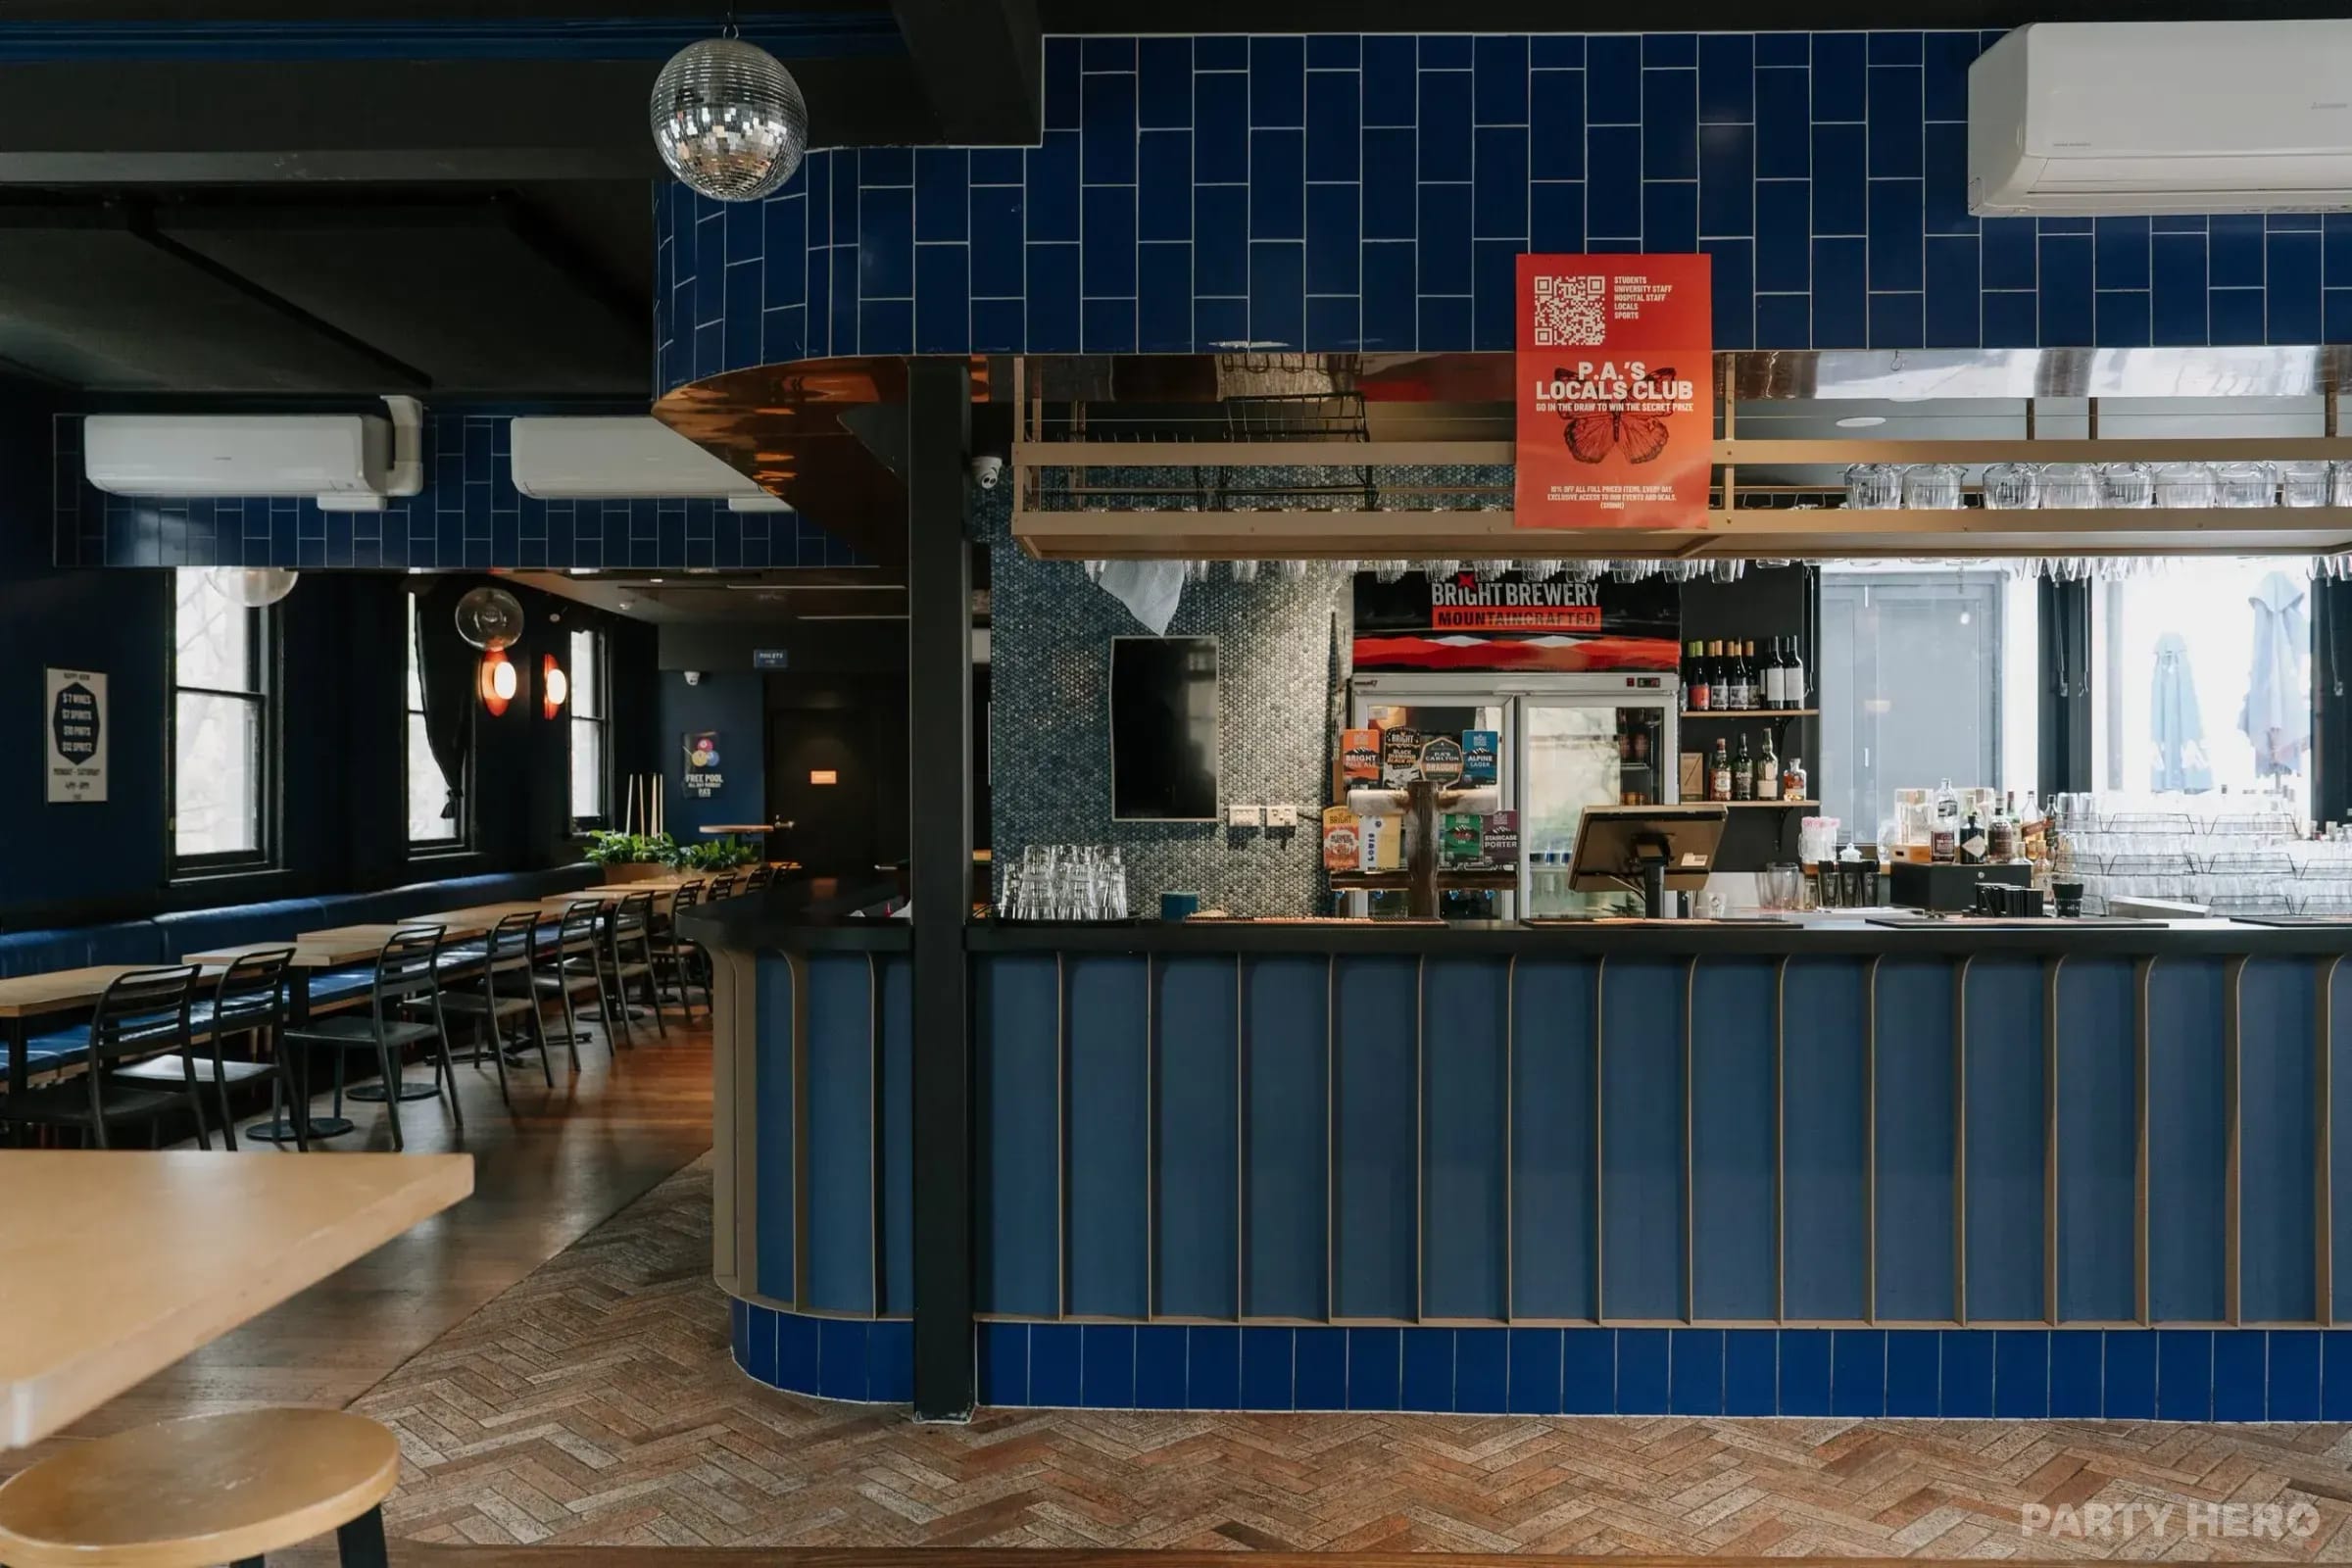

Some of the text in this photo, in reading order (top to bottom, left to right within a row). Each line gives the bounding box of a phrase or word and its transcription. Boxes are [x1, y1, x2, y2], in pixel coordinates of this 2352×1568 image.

[1614, 275, 1646, 284] STUDENTS
[1614, 284, 1672, 293] UNIVERSITY STAFF
[1536, 380, 1693, 400] LOCALS CLUB
[1537, 403, 1693, 412] GO IN THE DRAW TO WIN THE SECRET PRIZE
[1432, 582, 1599, 607] BRIGHT BREWERY
[1437, 611, 1596, 627] MOUNTAINCRAFTED
[686, 773, 724, 783] FREE POOL
